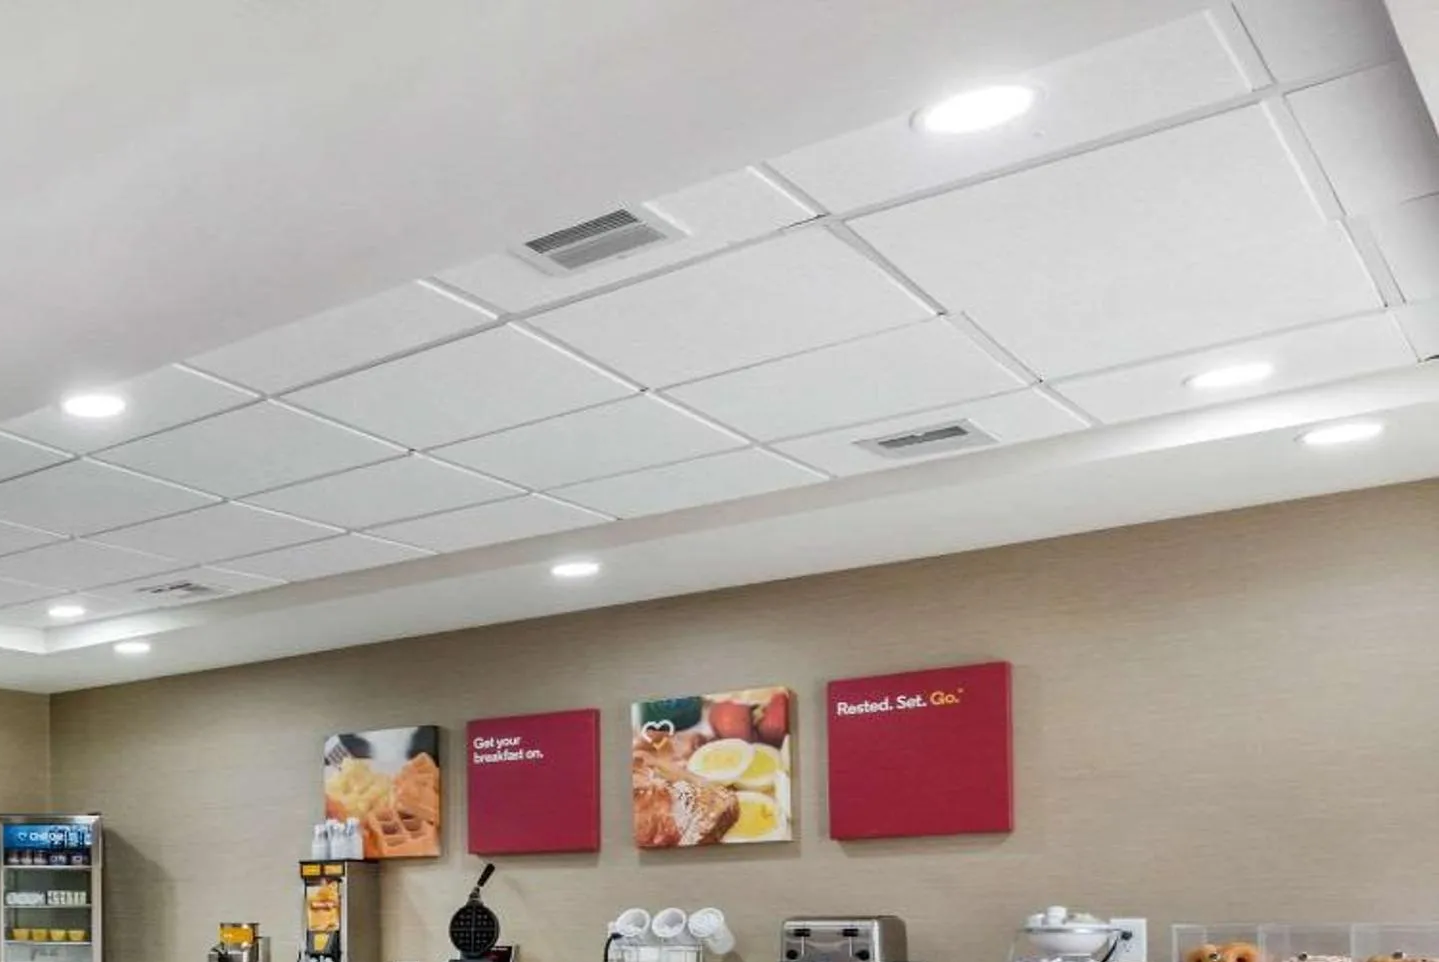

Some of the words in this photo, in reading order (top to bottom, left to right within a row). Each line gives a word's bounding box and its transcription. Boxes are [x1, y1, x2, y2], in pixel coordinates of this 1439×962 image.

[837, 697, 893, 716] Rested.
[896, 695, 927, 709] Set.
[472, 737, 494, 749] Get
[496, 736, 521, 749] your
[473, 749, 523, 764] breakfast
[525, 750, 544, 759] on.
